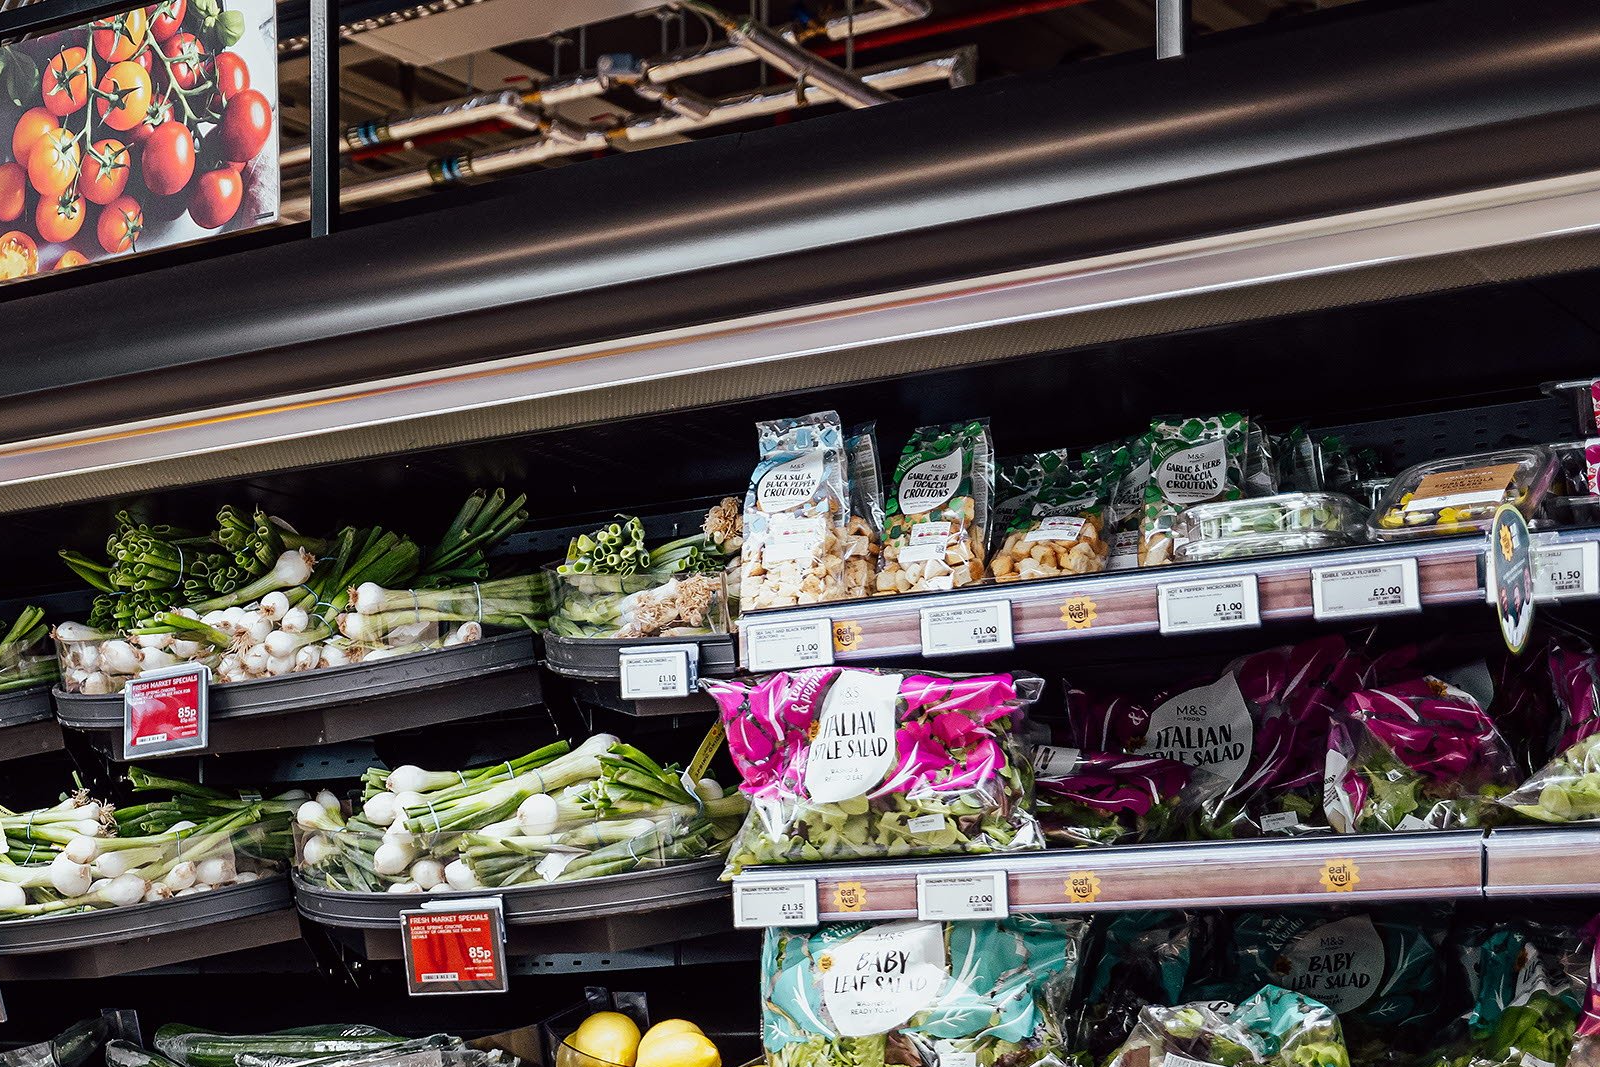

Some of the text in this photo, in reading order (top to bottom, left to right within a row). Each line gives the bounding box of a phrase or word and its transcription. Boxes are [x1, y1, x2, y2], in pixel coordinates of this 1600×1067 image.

[1166, 458, 1222, 473] GARLIC & HERB
[774, 472, 813, 481] SEA SALT &
[907, 471, 959, 482] GARLIC & HERB
[1175, 470, 1213, 481] FOCACCIA
[765, 479, 817, 488] BLACK PEPPER
[913, 480, 949, 489] FOCACCIA
[1166, 478, 1218, 490] CROUTONS
[763, 486, 811, 498] CROUTONS
[903, 487, 950, 499] CROUTONS
[1551, 571, 1581, 581] £1.50
[1373, 586, 1401, 596] £2.00
[1068, 601, 1085, 611] eat
[1216, 602, 1242, 612] £1.00
[1068, 608, 1089, 619] well
[836, 626, 852, 635] eat
[973, 626, 997, 635] £1.00
[836, 634, 855, 642] well
[796, 643, 818, 652] £1.00
[132, 675, 197, 691] FRESH MARKET SPECIALS
[658, 674, 677, 683] £1.10
[177, 706, 196, 719] 85p
[1176, 705, 1207, 716] M&S
[1156, 723, 1231, 750] ITALIAN
[847, 736, 888, 758] SALAD
[1193, 742, 1245, 766] SALAD
[1328, 864, 1347, 874] eat
[1072, 877, 1089, 886] eat
[1328, 872, 1351, 882] well
[840, 888, 856, 896] eat
[1072, 883, 1093, 894] well
[840, 895, 859, 904] well
[969, 894, 993, 903] £2.00
[781, 903, 804, 912] £1.35
[410, 916, 430, 924] FRESH
[458, 913, 489, 921] SPECIALS
[1320, 936, 1345, 946] M&S
[468, 947, 490, 959] 85p
[856, 950, 911, 974] BABY
[1308, 952, 1355, 973] BABY
[834, 975, 870, 994] LEAF
[1291, 973, 1371, 990] LEAF SALAD
